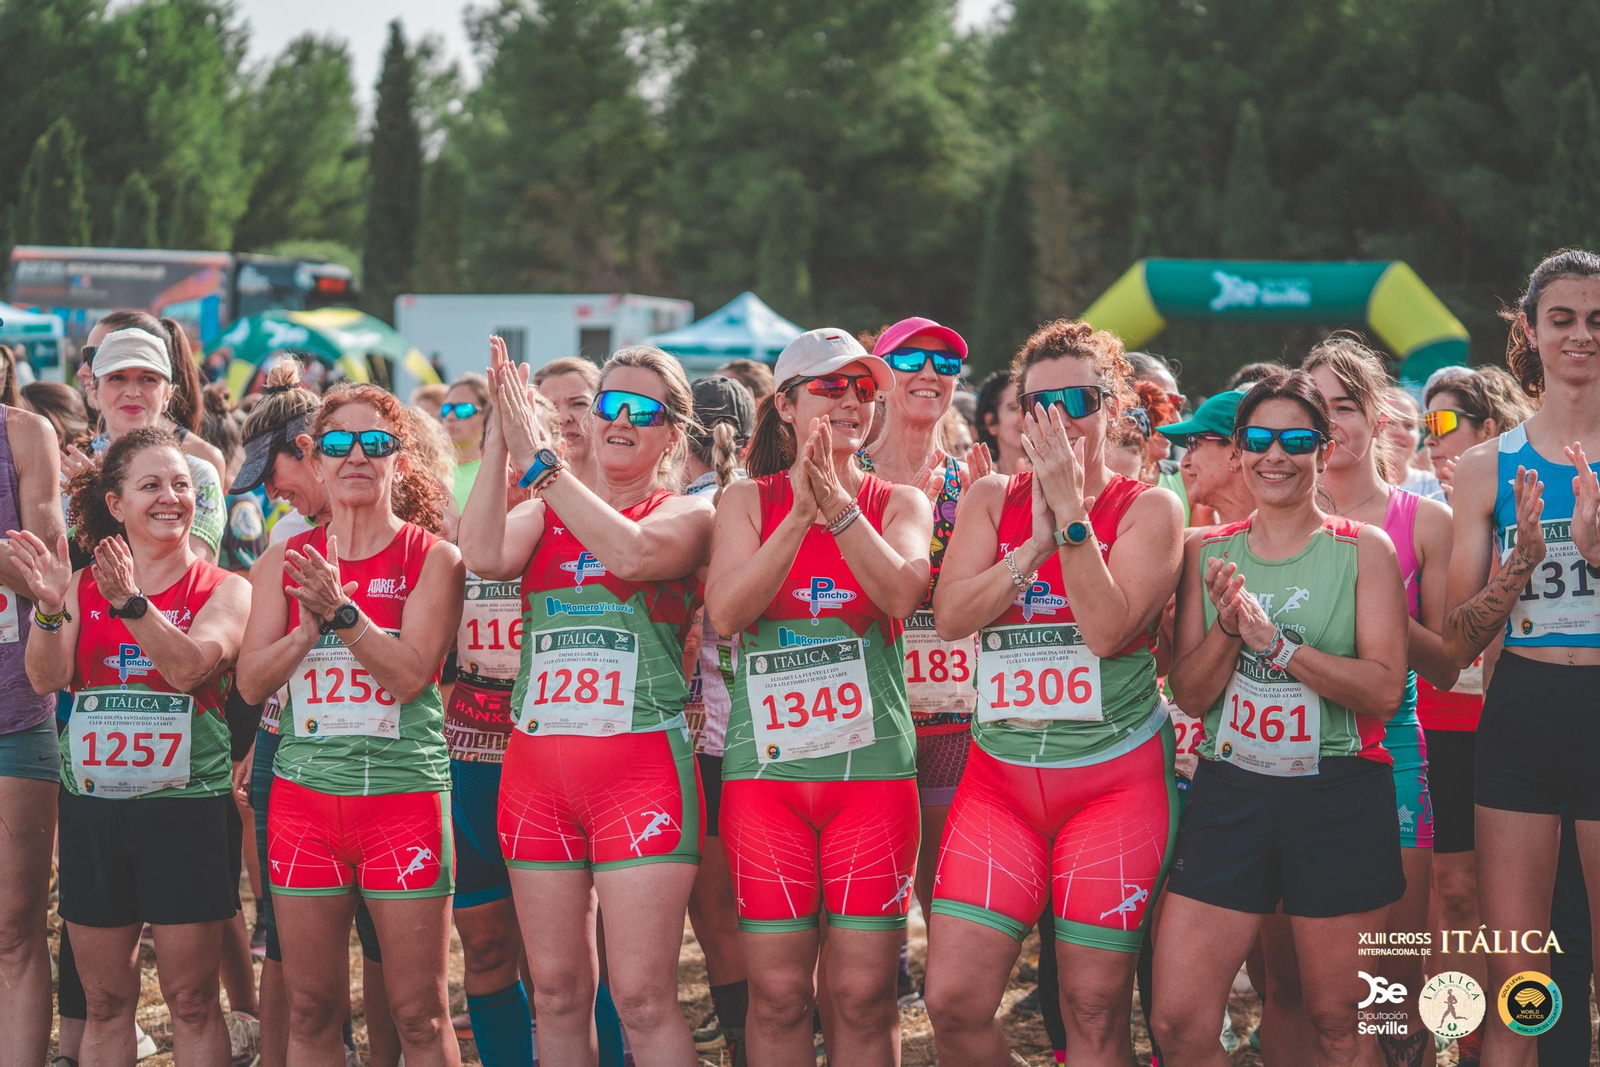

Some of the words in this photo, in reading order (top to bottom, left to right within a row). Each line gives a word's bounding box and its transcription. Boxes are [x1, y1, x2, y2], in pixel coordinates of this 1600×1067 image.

[1542, 524, 1571, 539] TÁLI
[367, 578, 395, 594] ATARFE
[485, 584, 521, 597] ITÁLIC
[811, 577, 848, 600] Poncho
[557, 631, 606, 646] ITÁLICA
[1008, 630, 1064, 646] ITÁLICA
[120, 644, 152, 667] Poncho
[774, 650, 830, 669] ITÁLICA
[906, 649, 970, 683] 183
[534, 668, 625, 706] 1281
[990, 666, 1092, 708] 1306
[105, 694, 160, 710] ITÁLICA
[762, 682, 862, 730] 1349
[1230, 694, 1312, 742] 1261
[82, 732, 182, 767] 1257
